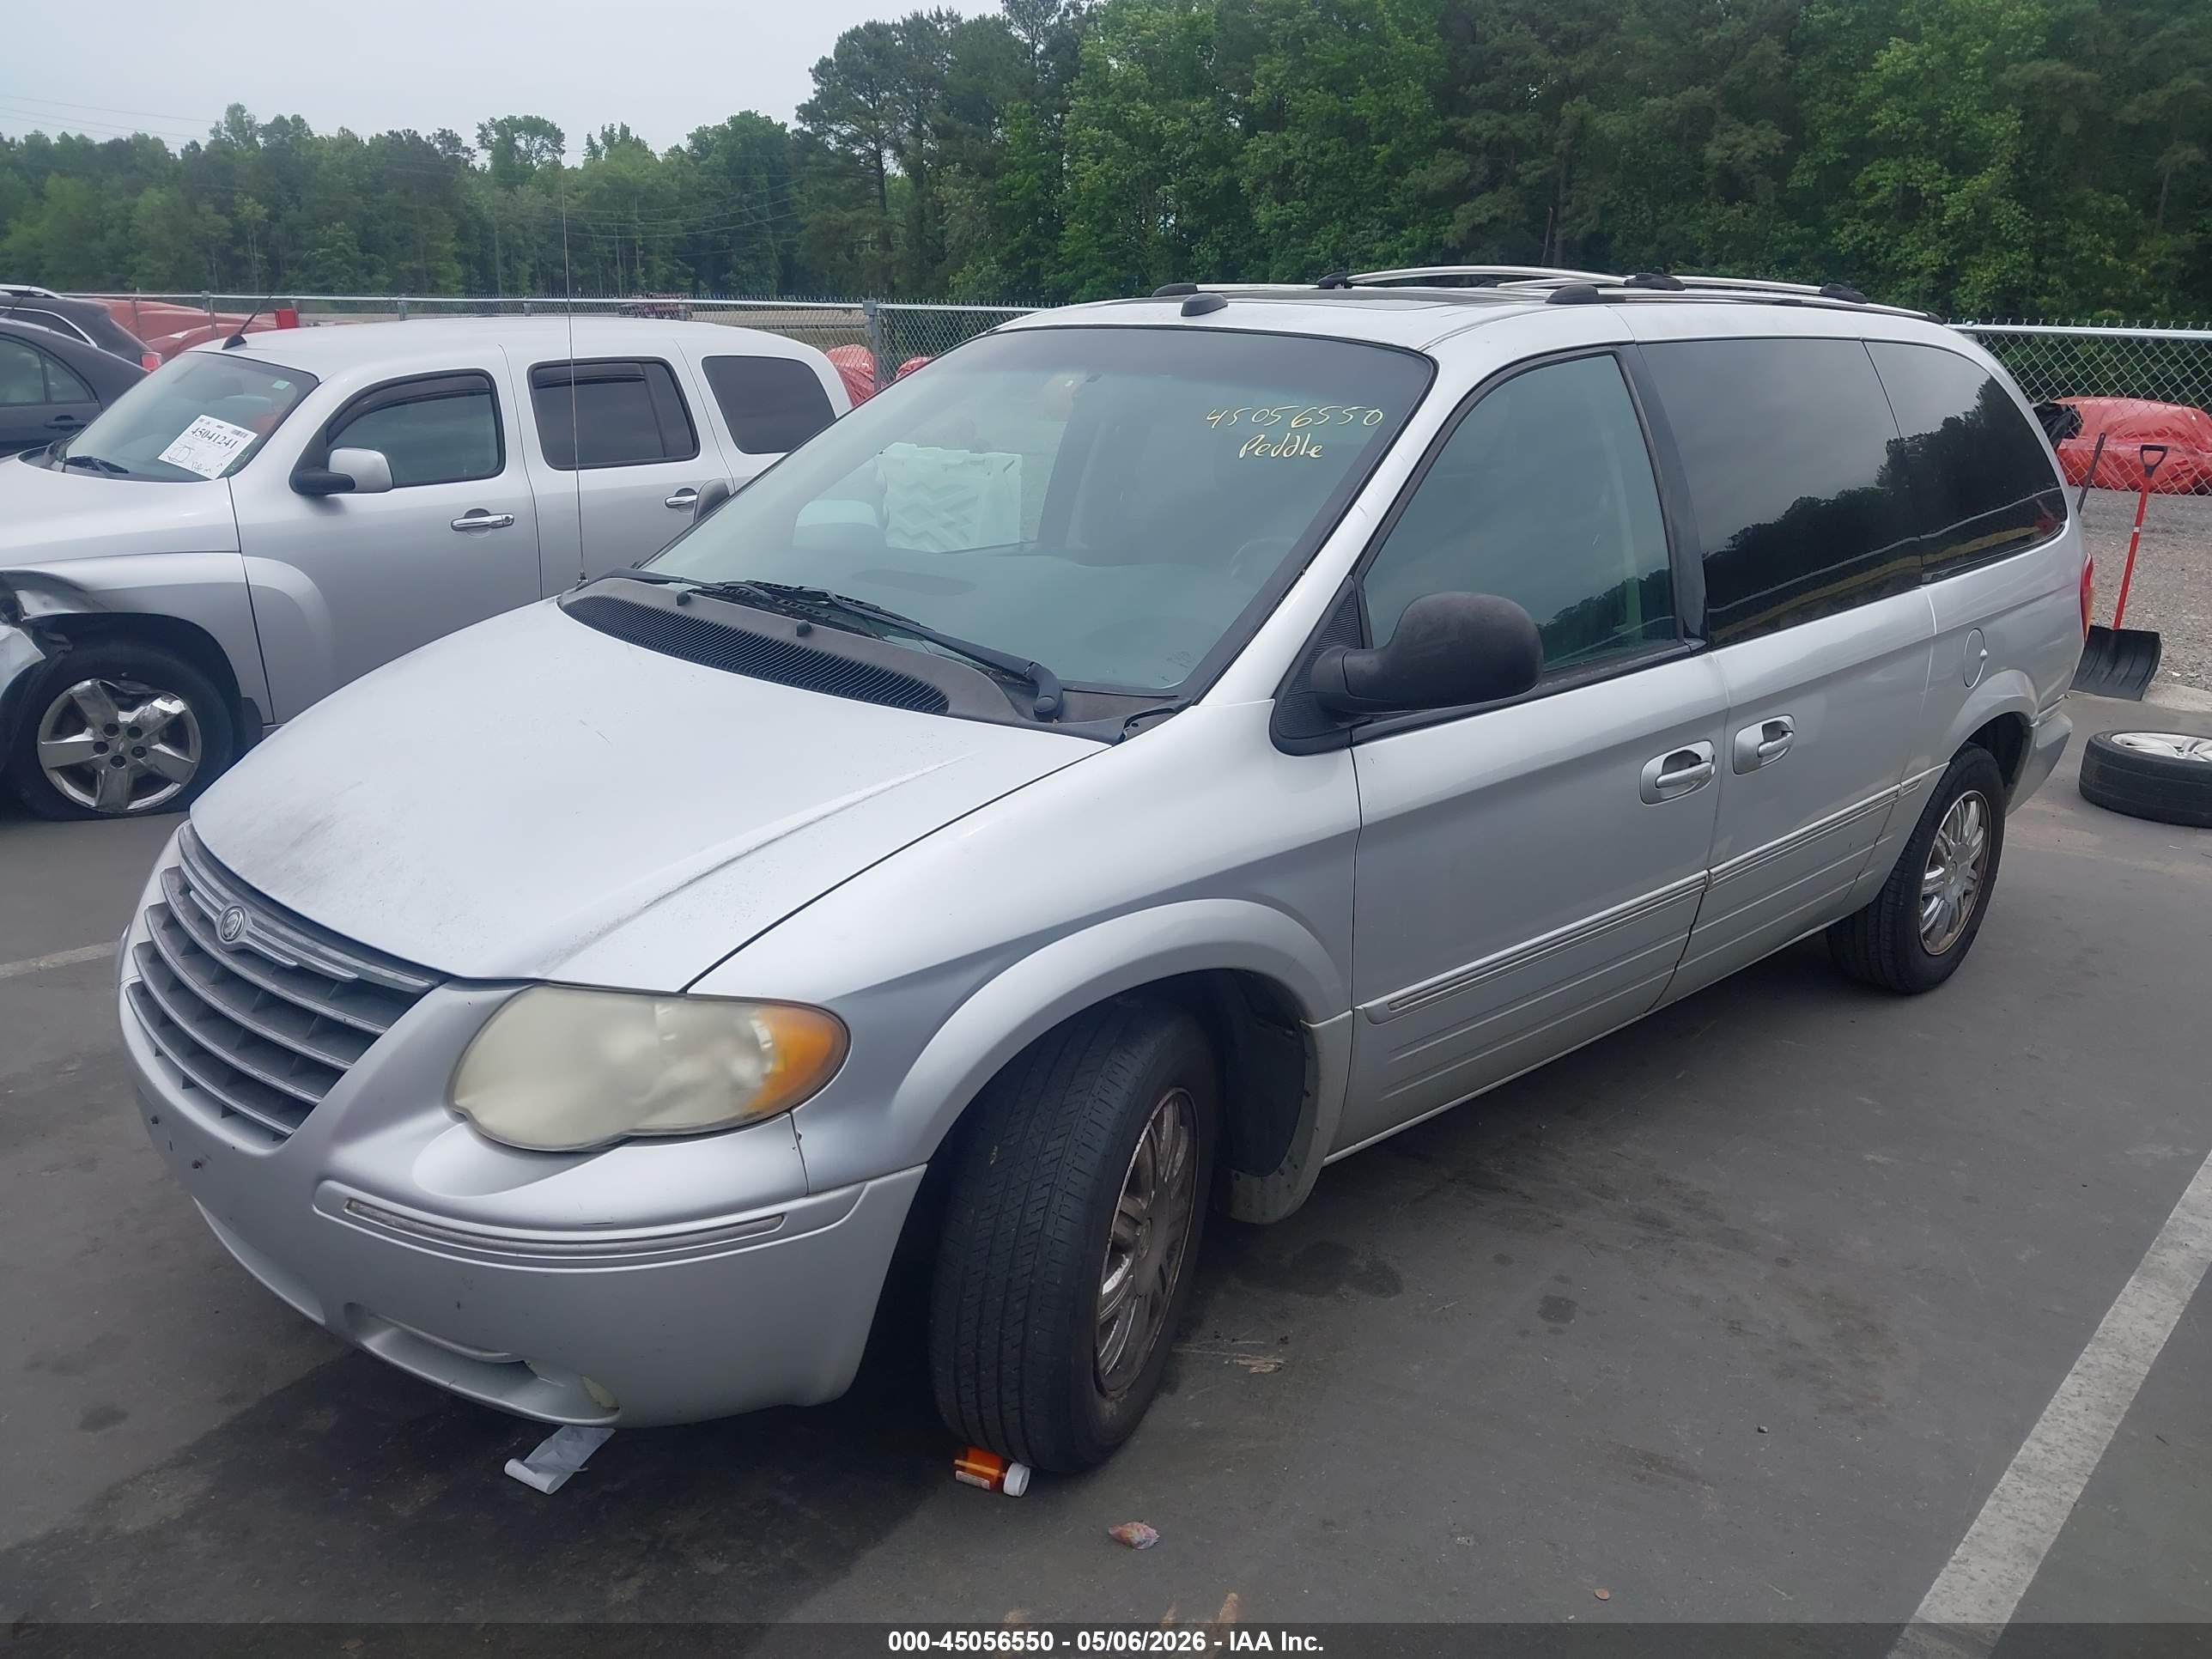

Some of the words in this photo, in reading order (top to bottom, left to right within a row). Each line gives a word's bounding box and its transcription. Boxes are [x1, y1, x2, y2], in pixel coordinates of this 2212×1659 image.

[1206, 405, 1384, 429] 45056550
[191, 427, 239, 449] 45041241
[1238, 432, 1324, 459] Peddle
